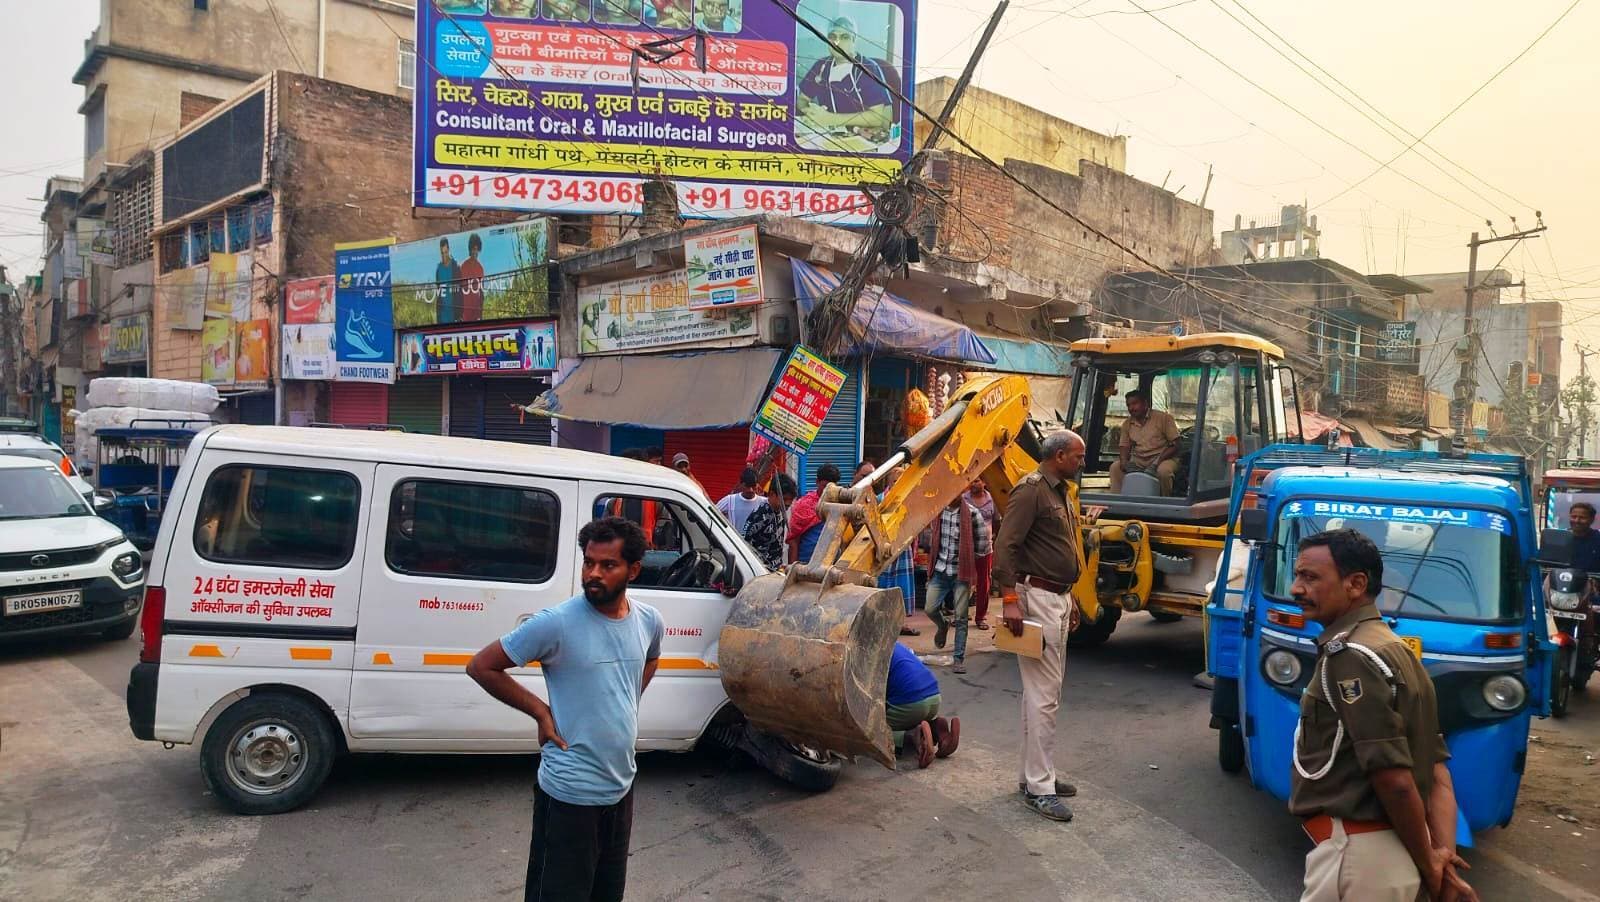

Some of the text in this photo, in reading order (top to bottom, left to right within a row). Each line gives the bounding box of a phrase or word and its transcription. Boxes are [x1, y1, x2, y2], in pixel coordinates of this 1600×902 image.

[495, 29, 542, 43] गुटखा
[548, 30, 570, 43] एवं
[706, 40, 738, 54] होने
[496, 44, 532, 56] वाली
[538, 45, 608, 61] बीमारियों
[613, 51, 631, 62] का
[717, 58, 782, 72] ऑपरेशन
[531, 64, 545, 76] के
[594, 69, 630, 82] (Oral
[640, 75, 691, 89] ancer)
[698, 77, 716, 88] का
[721, 78, 783, 92] ऑपरेशन
[436, 79, 788, 123] सिर, चेहरा, गला, मुख एवं जबड़े के सर्जन
[436, 110, 787, 148] Consultant Oral & Maxillofacial Surgeon
[443, 142, 501, 159] महात्मा
[507, 143, 549, 161] गांधी
[596, 147, 657, 166] पंचवटी
[663, 150, 707, 169] होटल
[715, 154, 731, 171] के
[739, 156, 789, 175] सामने,
[797, 160, 864, 182] भागलपुर
[432, 174, 480, 197] +91
[686, 187, 731, 209] +91
[462, 273, 515, 295] JOCKEY
[707, 268, 722, 281] जाने
[725, 268, 735, 279] का
[425, 328, 519, 357] मनपसन्द
[340, 365, 389, 379] CHAND FOOTWEAR
[1314, 502, 1387, 516] BIRAT
[1392, 507, 1468, 521] BAJAJ
[16, 572, 70, 583] PUNCH
[193, 576, 213, 595] 24
[243, 577, 307, 597] इमरजेन्सी
[309, 579, 336, 599] सेवा
[190, 598, 332, 621] ऑक्सीजन की सुविधा उपलब्ध
[419, 596, 484, 611] mob 7631666652
